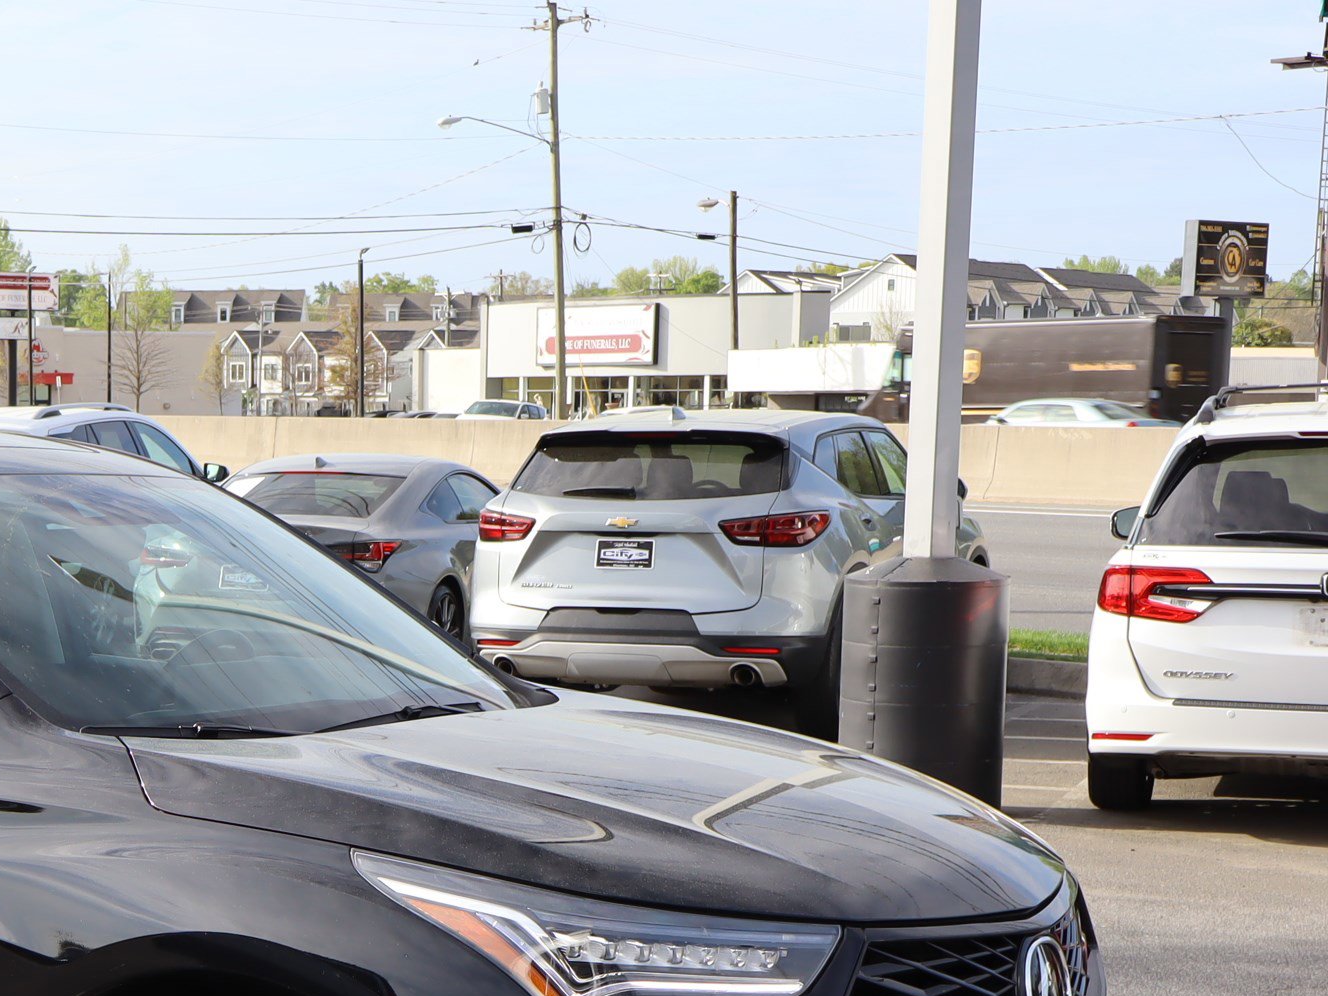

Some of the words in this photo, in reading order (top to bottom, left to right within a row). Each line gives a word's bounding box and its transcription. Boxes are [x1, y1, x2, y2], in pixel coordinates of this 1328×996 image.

[574, 339, 584, 350] OF
[618, 338, 631, 349] LLC
[1163, 670, 1234, 680] ODYSSEY
